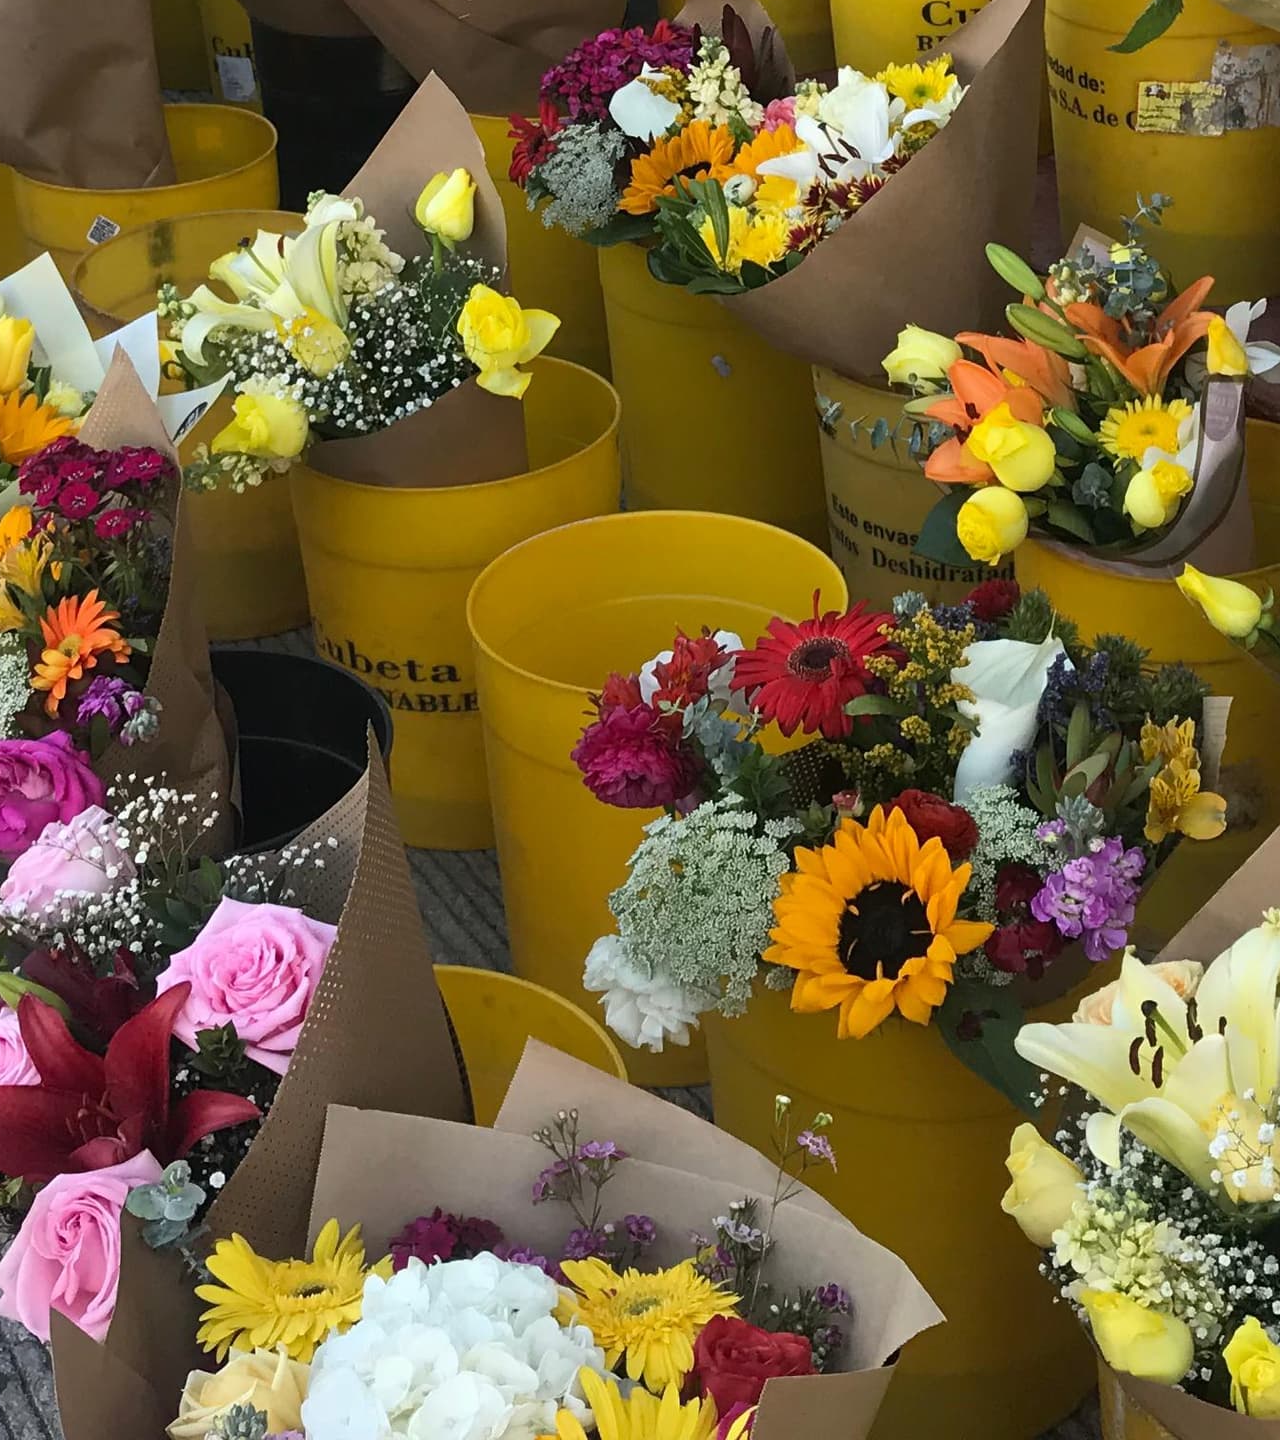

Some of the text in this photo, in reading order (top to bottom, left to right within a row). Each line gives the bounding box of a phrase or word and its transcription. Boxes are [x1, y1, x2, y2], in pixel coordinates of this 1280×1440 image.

[1093, 104, 1120, 128] de
[863, 517, 920, 548] envas
[319, 626, 462, 683] ubeta
